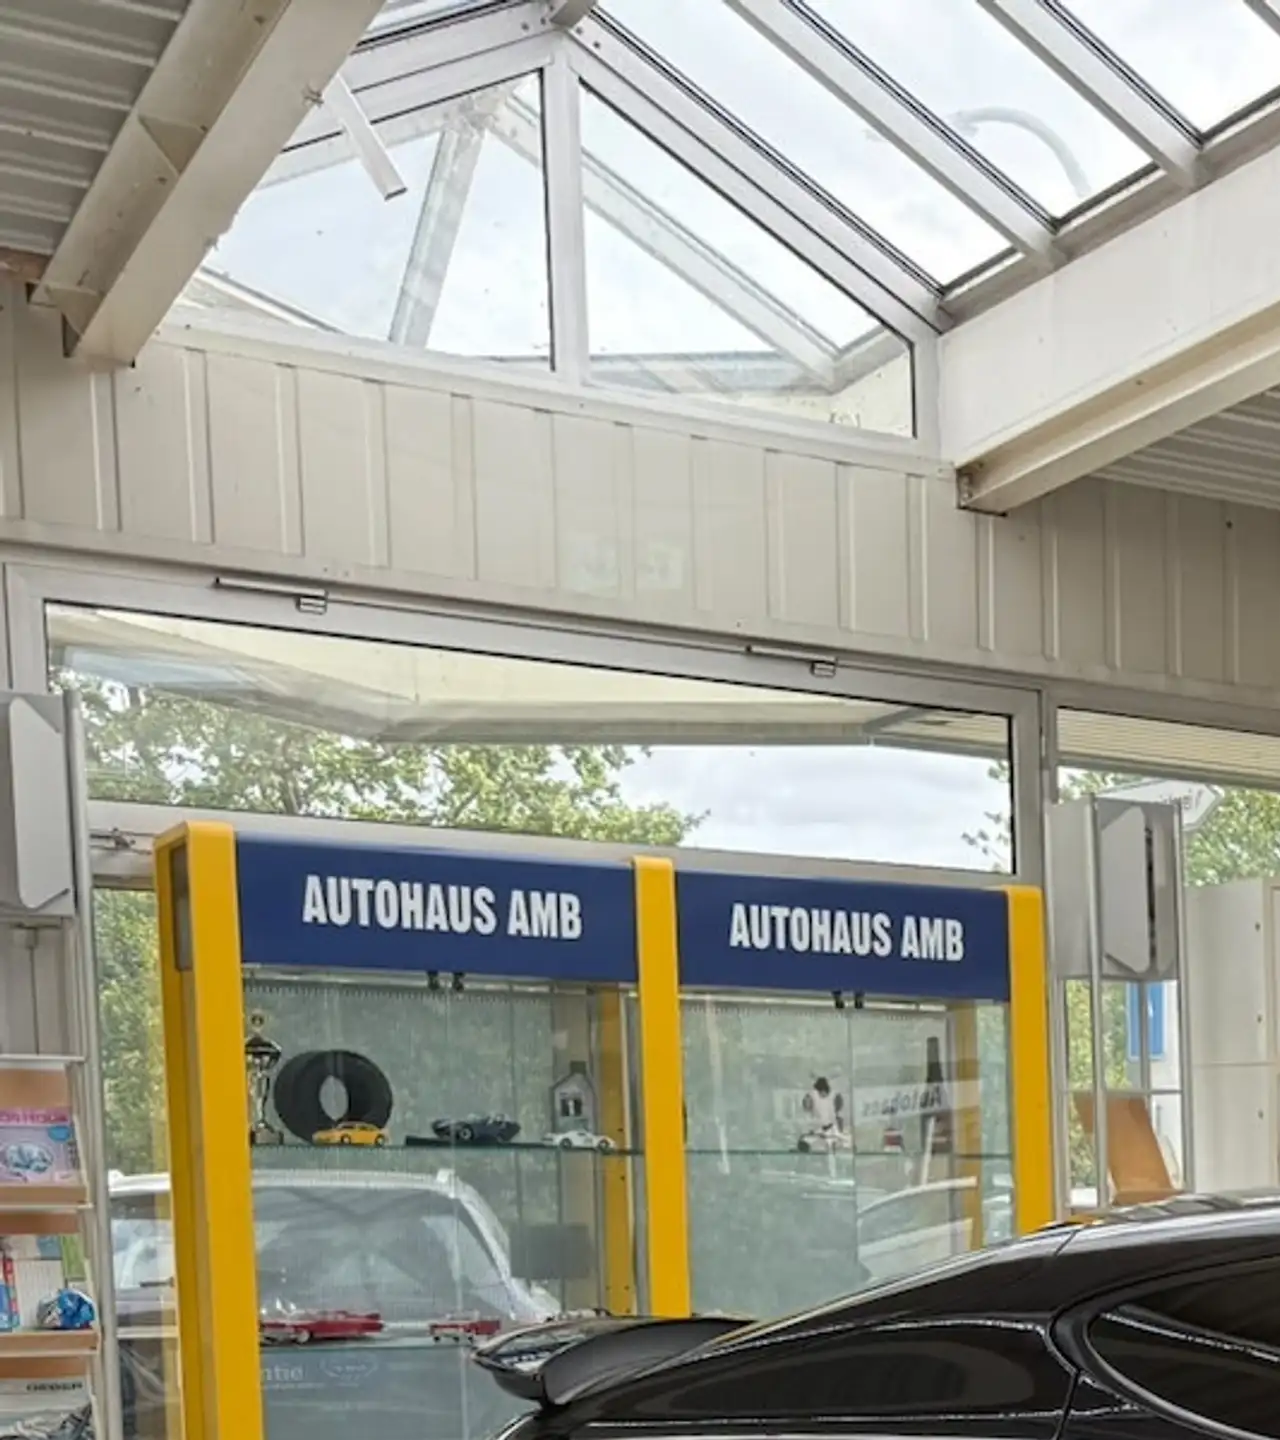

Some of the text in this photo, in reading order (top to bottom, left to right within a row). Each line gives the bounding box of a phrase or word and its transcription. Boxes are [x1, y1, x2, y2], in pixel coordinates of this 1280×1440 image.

[302, 875, 582, 939] AUTOHAUS AMB
[729, 903, 964, 962] AUTOHAUS AMB
